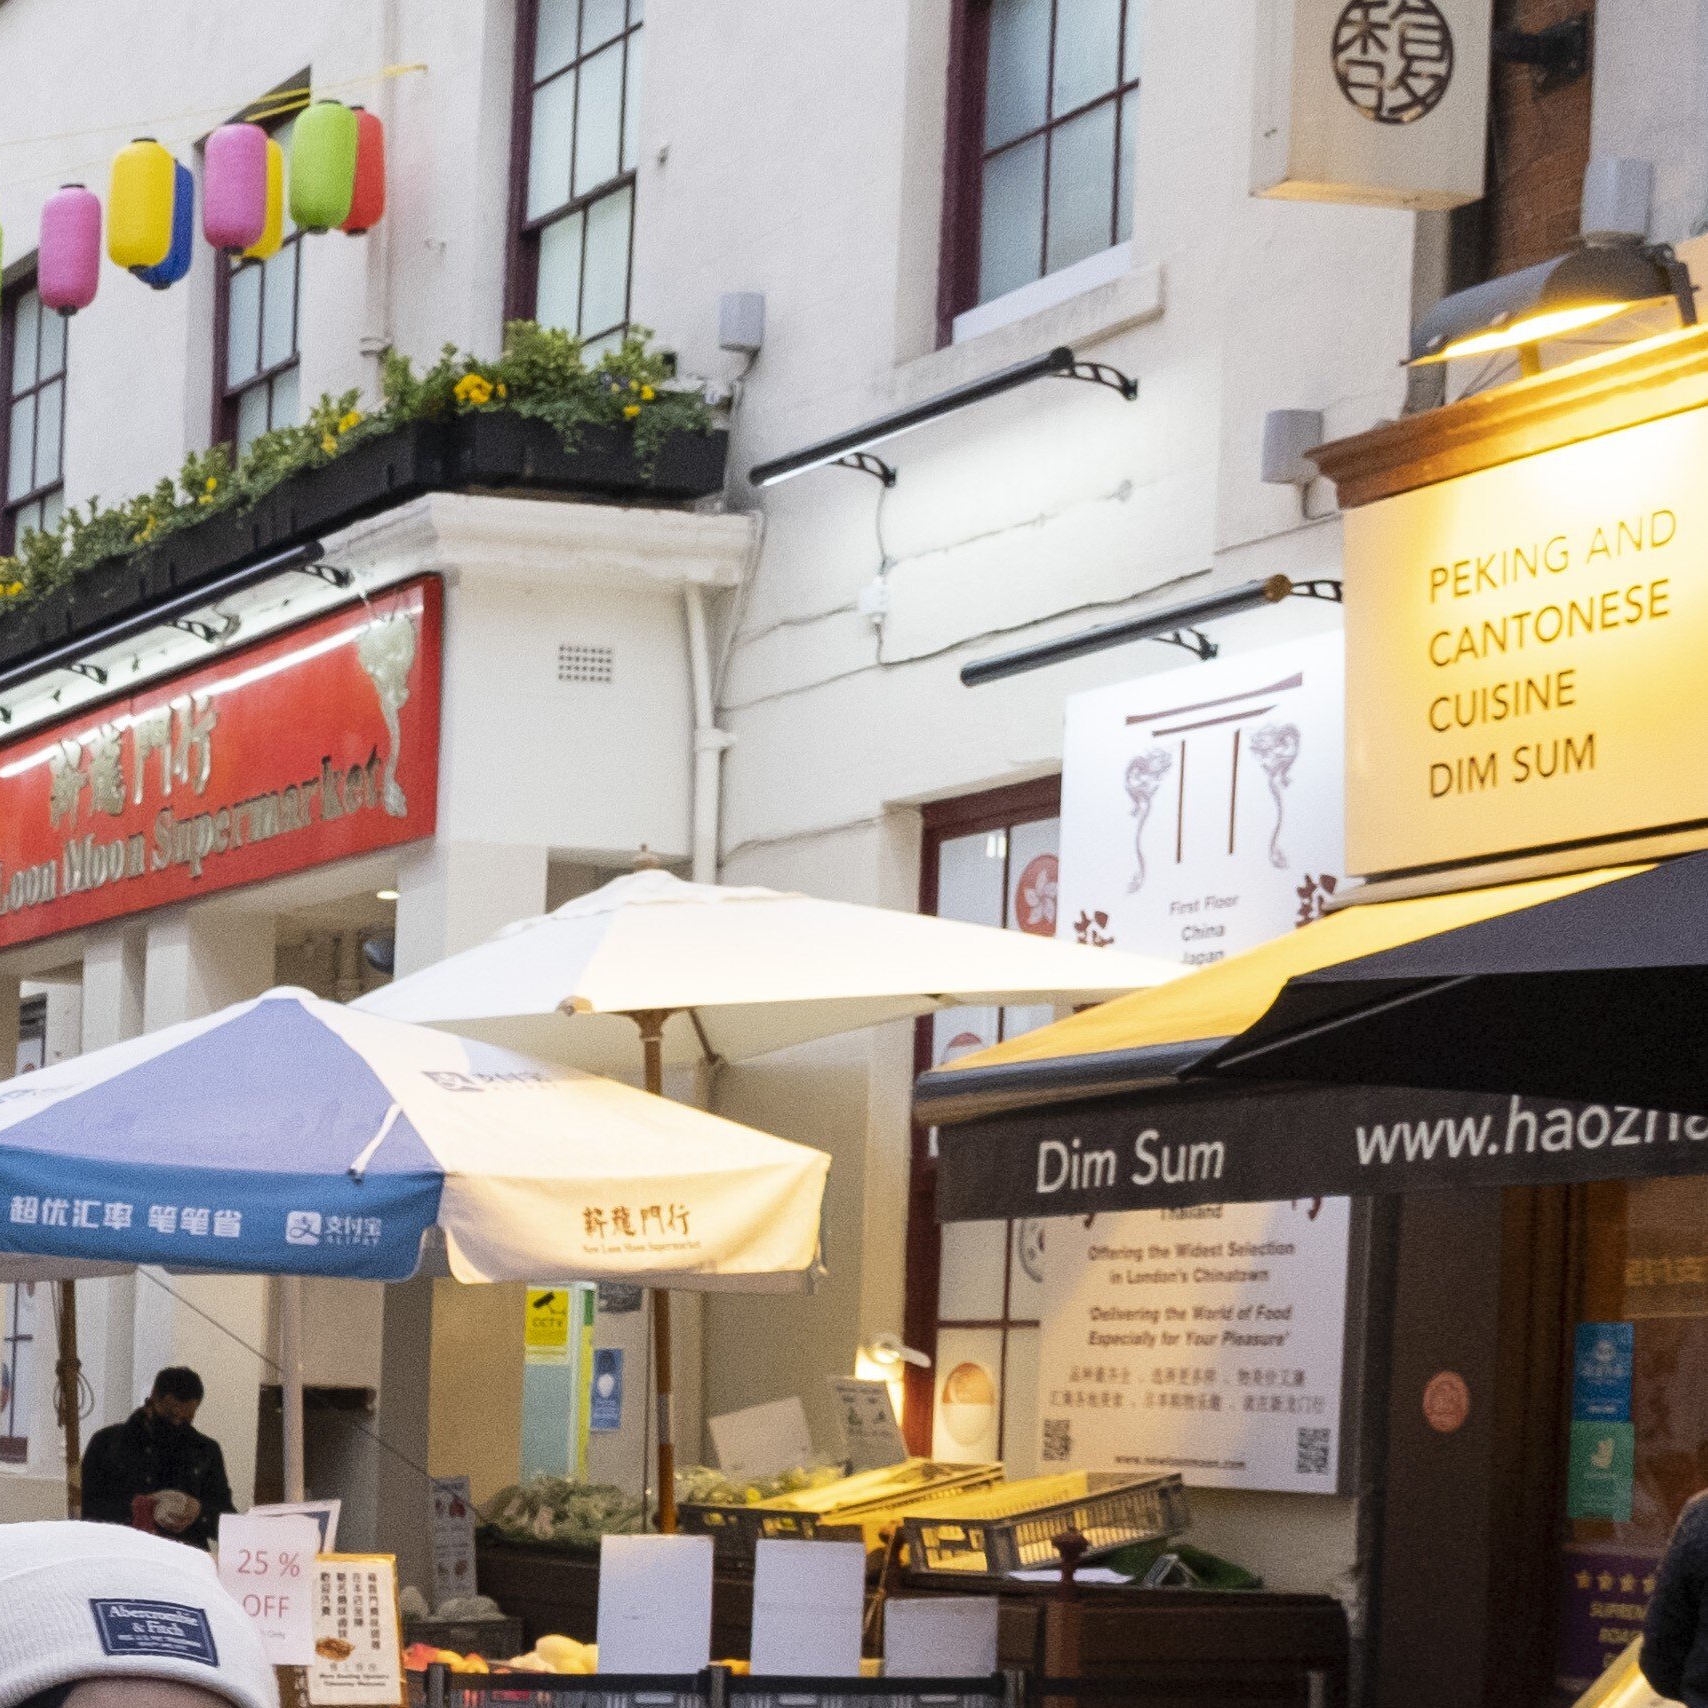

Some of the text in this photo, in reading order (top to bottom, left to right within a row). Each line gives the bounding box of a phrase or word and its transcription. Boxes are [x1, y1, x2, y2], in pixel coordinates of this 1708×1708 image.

[1430, 508, 1677, 604] PEKING AND
[1428, 577, 1670, 667] CANTONESE
[1428, 668, 1576, 733] CUISINE
[1429, 732, 1596, 799] DIM SUM
[61, 831, 145, 896] Moon
[151, 746, 382, 881] Supermarket
[1169, 894, 1240, 917] First Floor
[1181, 923, 1226, 942] China
[1183, 949, 1225, 967] Japan
[1036, 1128, 1226, 1194] Dim Sum
[9, 1195, 242, 1239] 超优汇率 笔笔省
[324, 1216, 383, 1238] 支付宝
[1088, 1241, 1295, 1262] Offering the Widest Selection
[1109, 1268, 1270, 1285] in London's Chinatown
[532, 1317, 564, 1328] CCTV
[1164, 1306, 1187, 1321] the
[1192, 1305, 1234, 1322] World
[1237, 1305, 1254, 1321] of
[1254, 1304, 1293, 1321] Food
[1088, 1330, 1157, 1350] Especially
[1160, 1331, 1180, 1346] for
[1185, 1331, 1218, 1346] Your
[237, 1549, 300, 1578] 25 %
[108, 1604, 200, 1627] Abercrombie
[242, 1593, 291, 1619] OFF
[131, 1619, 186, 1637] & Fitch
